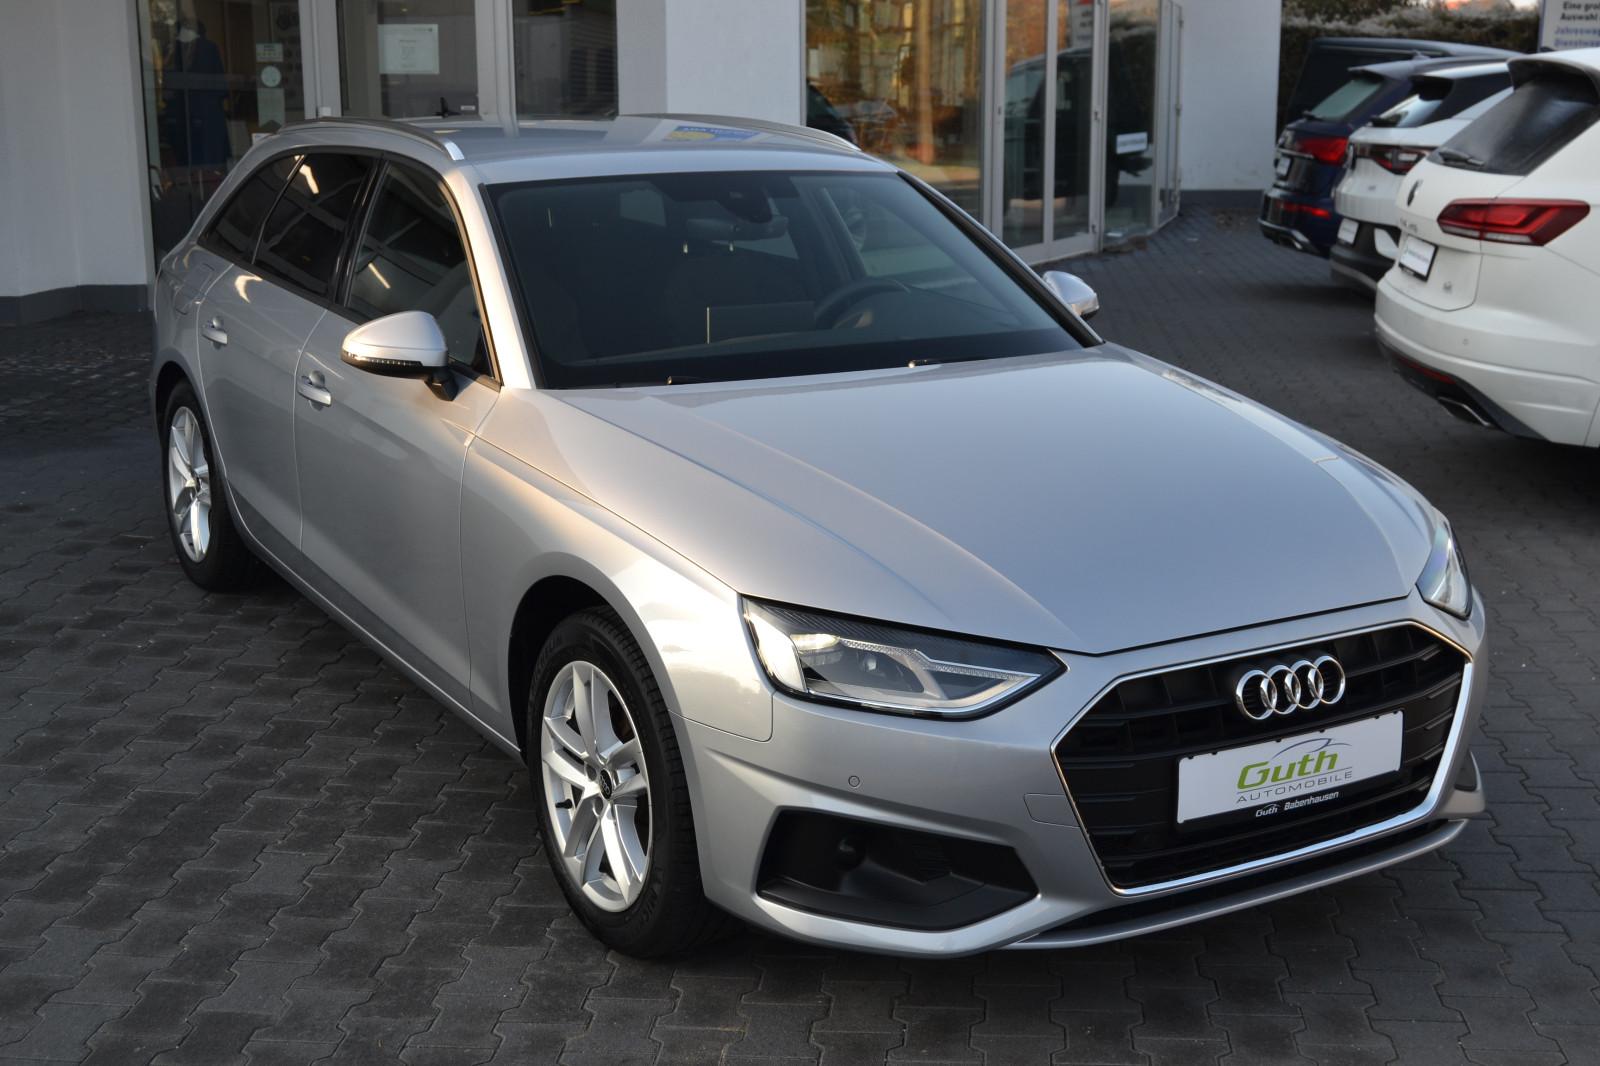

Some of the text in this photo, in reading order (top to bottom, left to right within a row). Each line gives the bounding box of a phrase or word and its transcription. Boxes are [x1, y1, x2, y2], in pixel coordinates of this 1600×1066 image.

[1560, 12, 1598, 20] Auswahl
[1563, 1, 1581, 10] Eine
[1236, 750, 1339, 790] Guth
[1235, 770, 1353, 804] AUTOMOBILE
[1255, 791, 1340, 818] Guth Babenhausen
